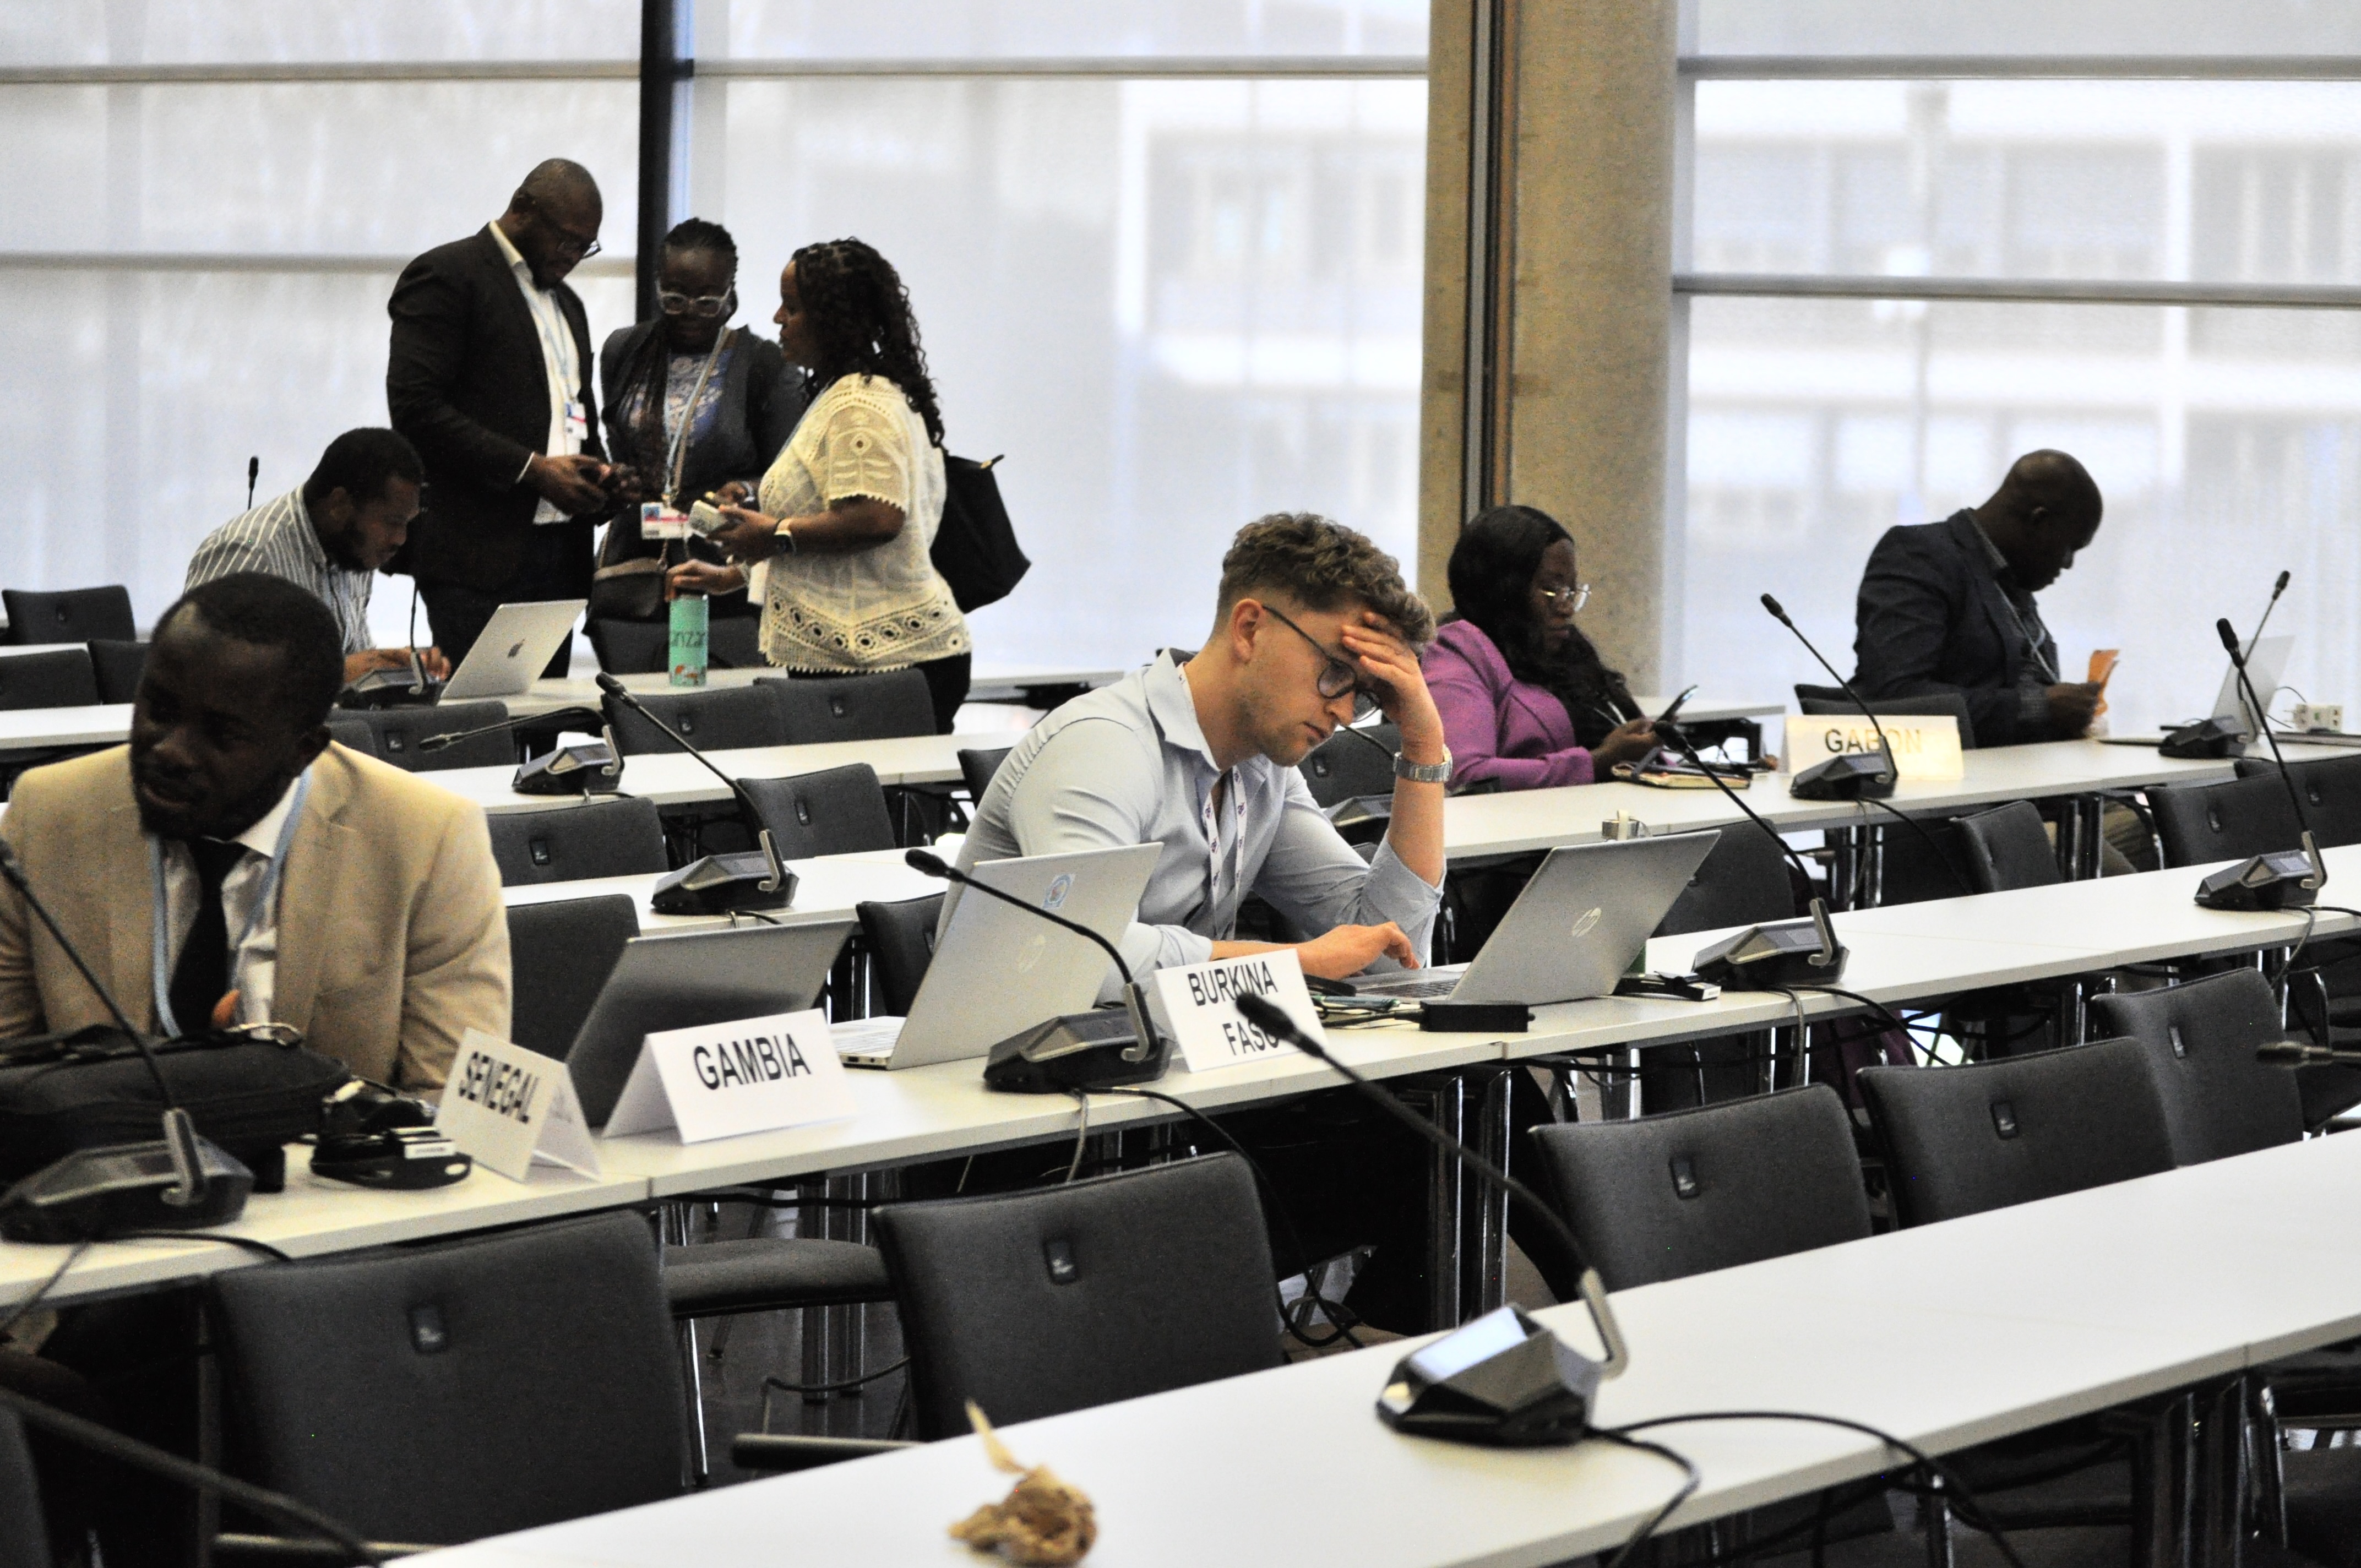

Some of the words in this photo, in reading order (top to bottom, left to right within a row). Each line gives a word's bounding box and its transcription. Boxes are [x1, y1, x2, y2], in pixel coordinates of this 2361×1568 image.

[1825, 728, 1923, 754] GABON
[1187, 961, 1279, 1006] BURKINA
[459, 1050, 541, 1124] SENEGAL
[693, 1033, 812, 1090] GAMBIA
